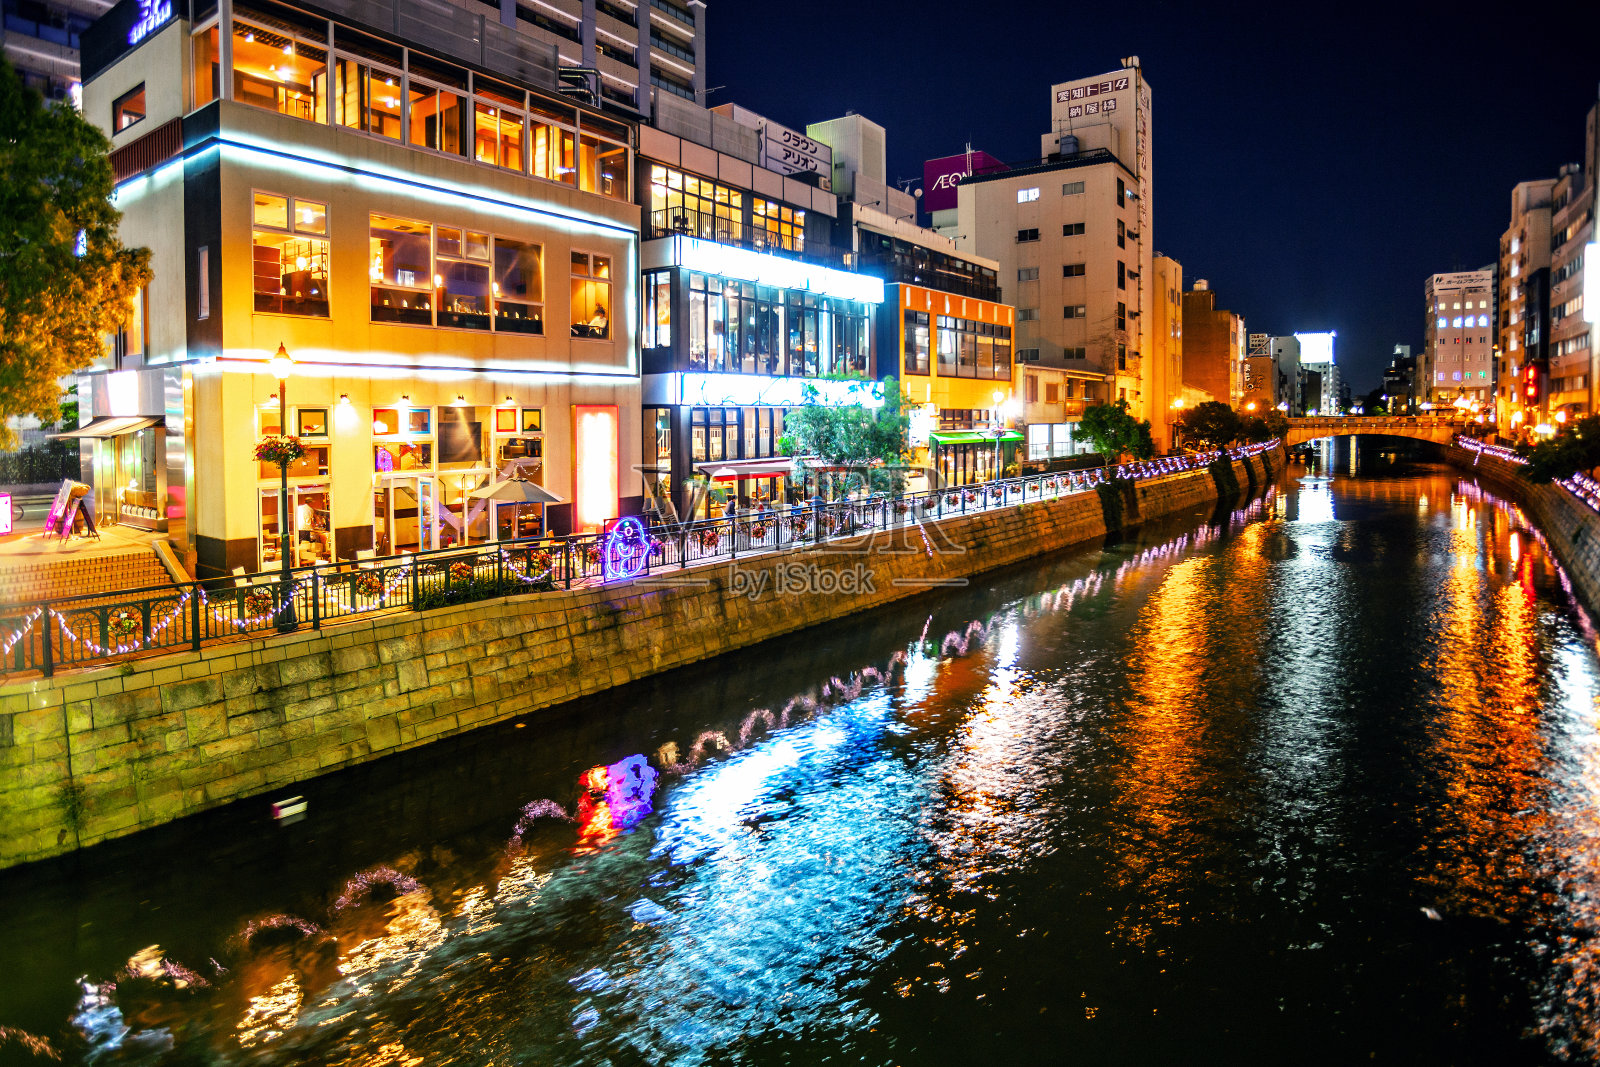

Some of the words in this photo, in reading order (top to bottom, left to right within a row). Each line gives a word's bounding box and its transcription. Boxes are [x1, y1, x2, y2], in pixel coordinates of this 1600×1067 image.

[1058, 78, 1127, 102] 愛知トヨタ
[1069, 99, 1116, 118] 納屋橋
[783, 131, 817, 154] クラウン
[783, 148, 818, 171] アリオン
